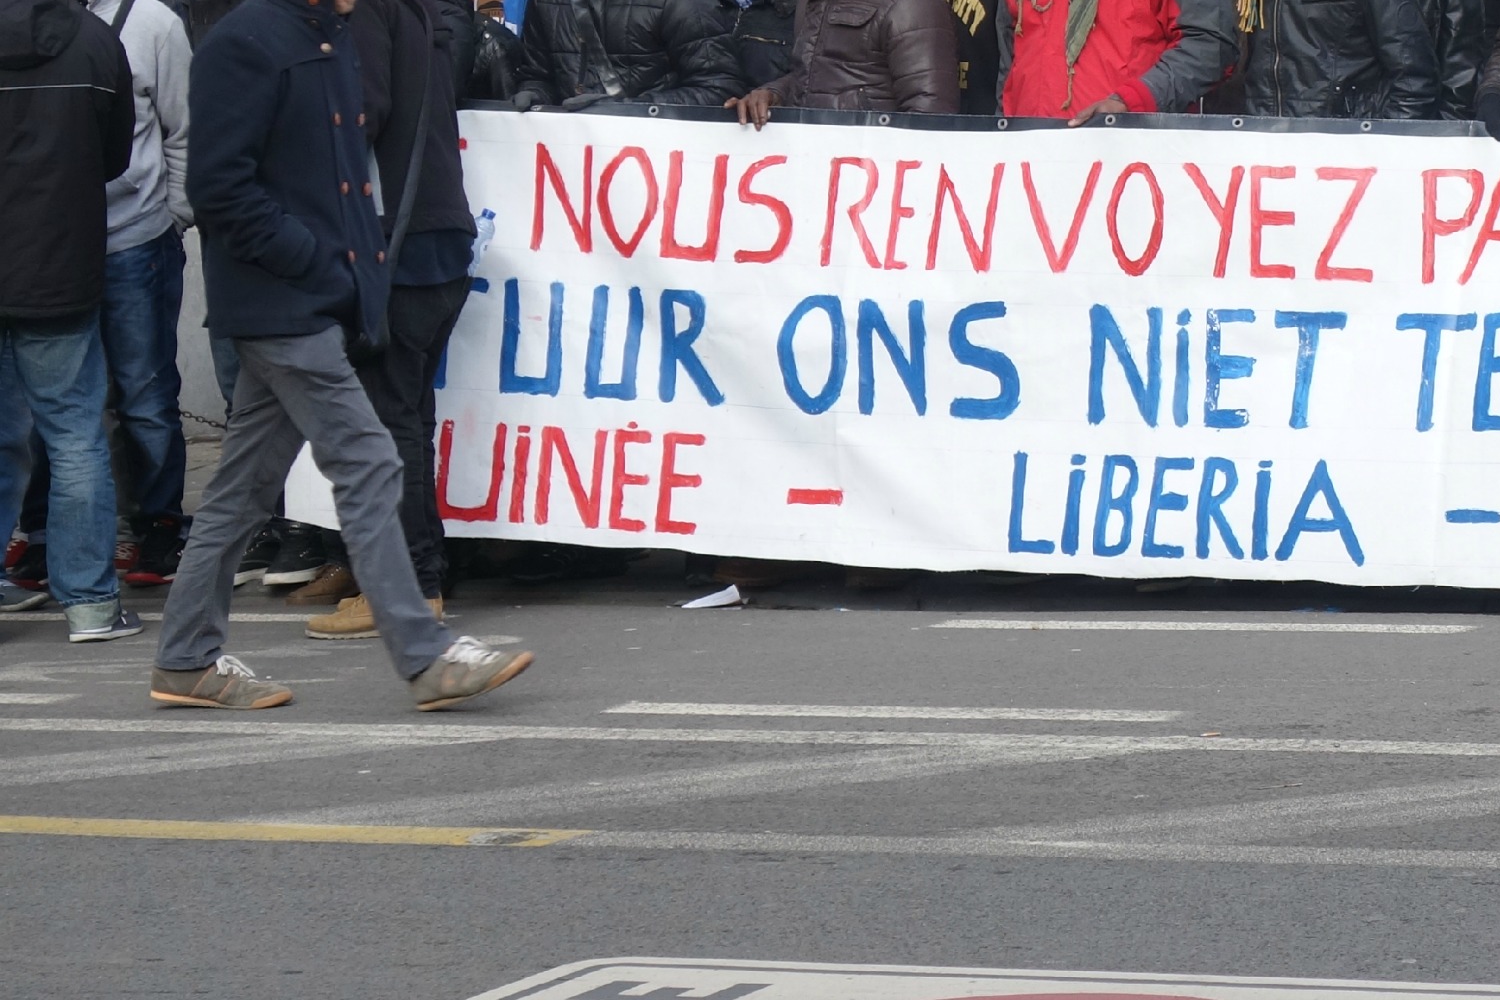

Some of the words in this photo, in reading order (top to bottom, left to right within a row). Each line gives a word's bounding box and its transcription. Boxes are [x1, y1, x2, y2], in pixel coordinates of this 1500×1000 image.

[531, 142, 793, 264] NOUS
[820, 157, 1376, 283] RENVOYEZ
[777, 294, 1021, 420] ONS
